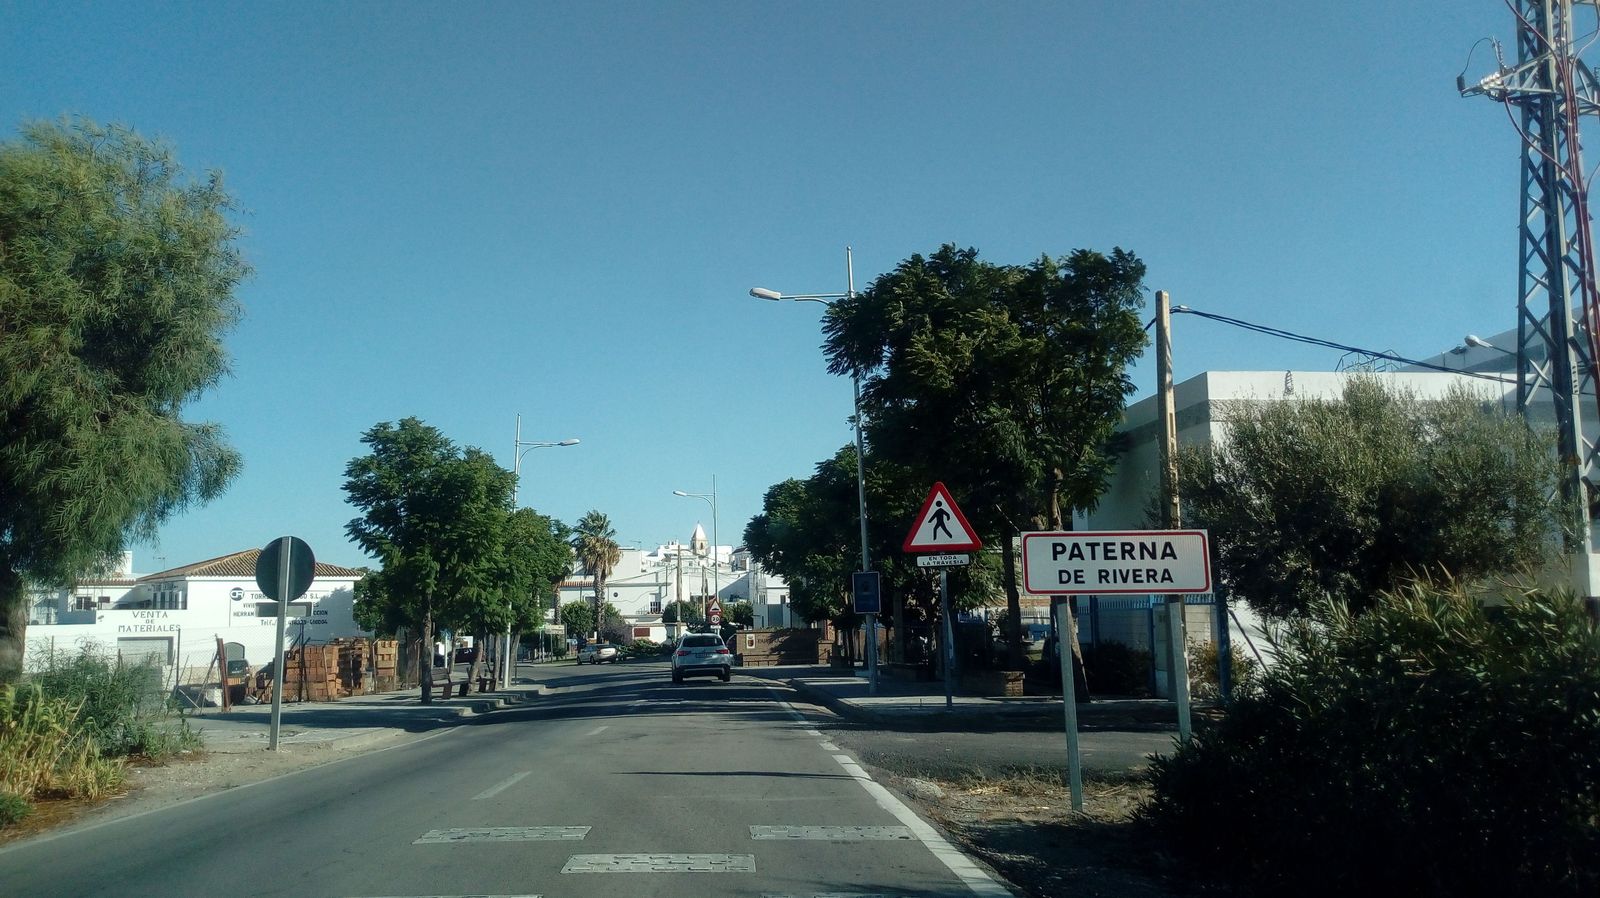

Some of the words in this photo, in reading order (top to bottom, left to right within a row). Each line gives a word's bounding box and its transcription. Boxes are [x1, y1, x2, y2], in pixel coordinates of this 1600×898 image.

[1052, 541, 1178, 561] PATERNA
[1058, 569, 1086, 585] DE
[1098, 568, 1175, 585] RIVERA
[132, 611, 168, 619] VENTA
[118, 624, 181, 633] MATERIALES
